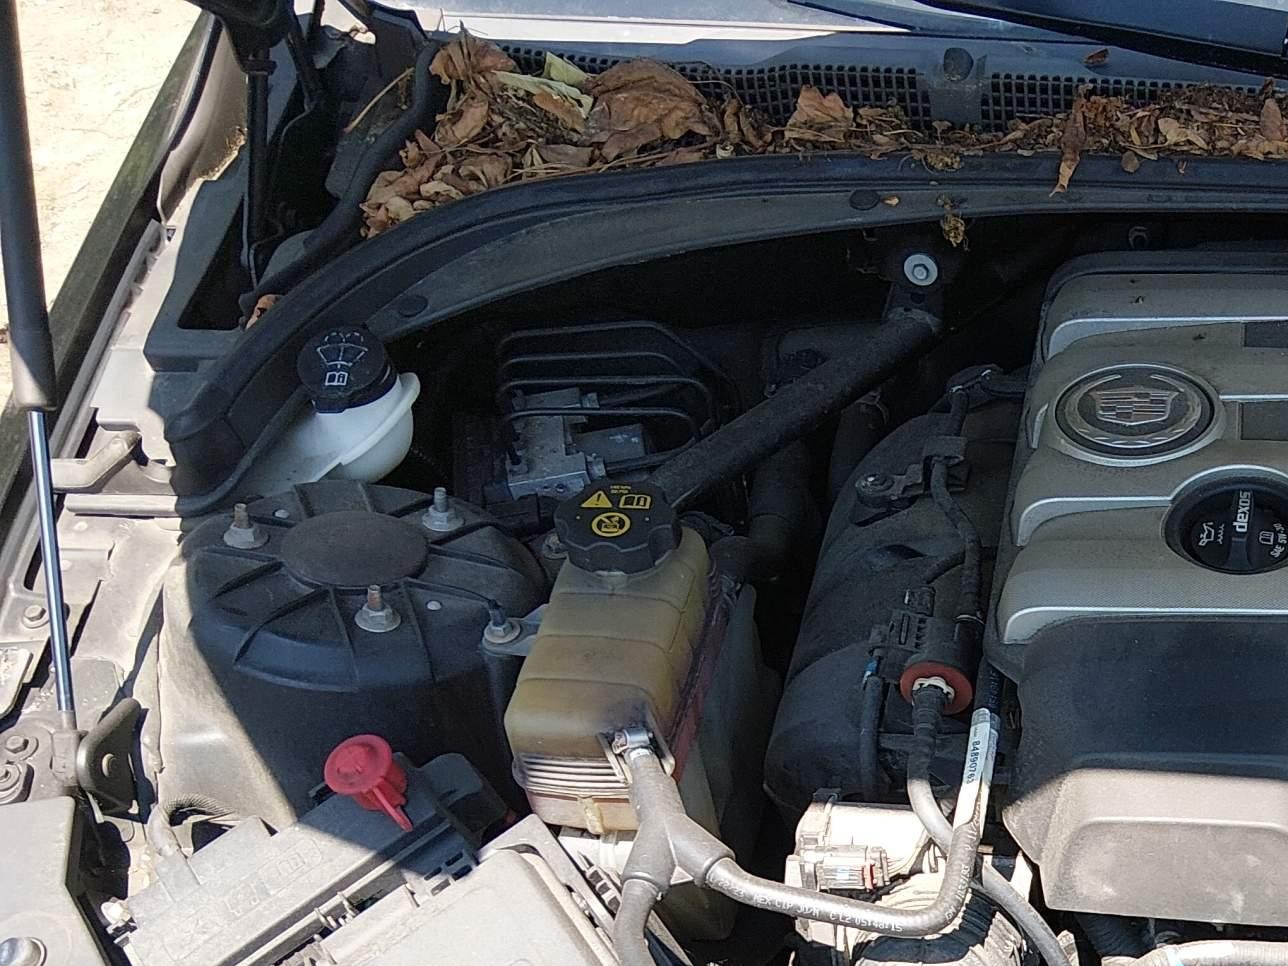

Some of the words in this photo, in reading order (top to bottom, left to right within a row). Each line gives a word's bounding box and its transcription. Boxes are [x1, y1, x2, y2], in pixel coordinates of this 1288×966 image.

[1232, 490, 1251, 533] dexos
[1273, 522, 1288, 545] 5W-30
[1270, 543, 1286, 558] SAE
